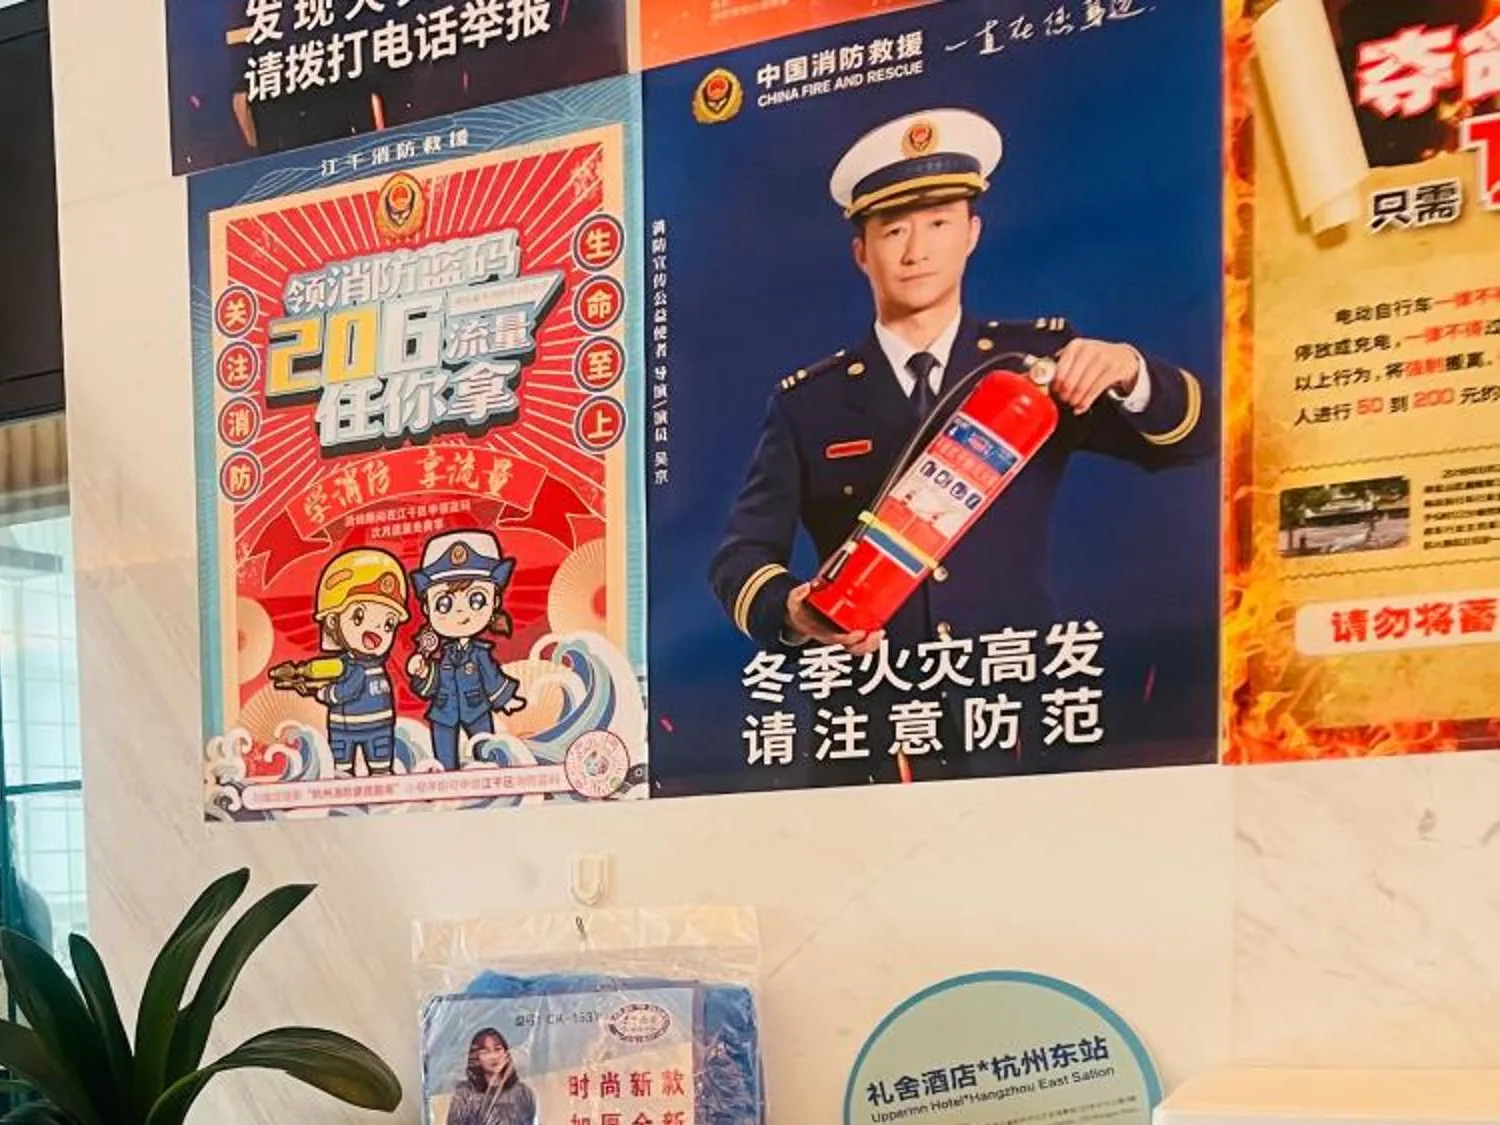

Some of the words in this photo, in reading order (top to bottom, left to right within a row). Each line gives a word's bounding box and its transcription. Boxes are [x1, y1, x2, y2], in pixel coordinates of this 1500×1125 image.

[244, 0, 551, 102] 请拨打电话举报
[757, 30, 923, 89] 中国消防救援
[757, 87, 799, 107] CHINA
[802, 80, 831, 98] FIRE
[834, 73, 863, 91] AND
[866, 60, 923, 83] RESCUE
[321, 127, 469, 176] 江干消防救援
[1369, 181, 1457, 230] 只需
[285, 231, 519, 314] 领消防蓝码
[586, 227, 614, 440] 生命至上
[225, 297, 252, 493] 关注消防
[316, 362, 519, 446] 任你拿
[742, 620, 1104, 703] 冬季火灾高发
[742, 687, 1104, 766] 请注意防范
[569, 1069, 685, 1099] 时尚新款
[1038, 1075, 1070, 1090] East
